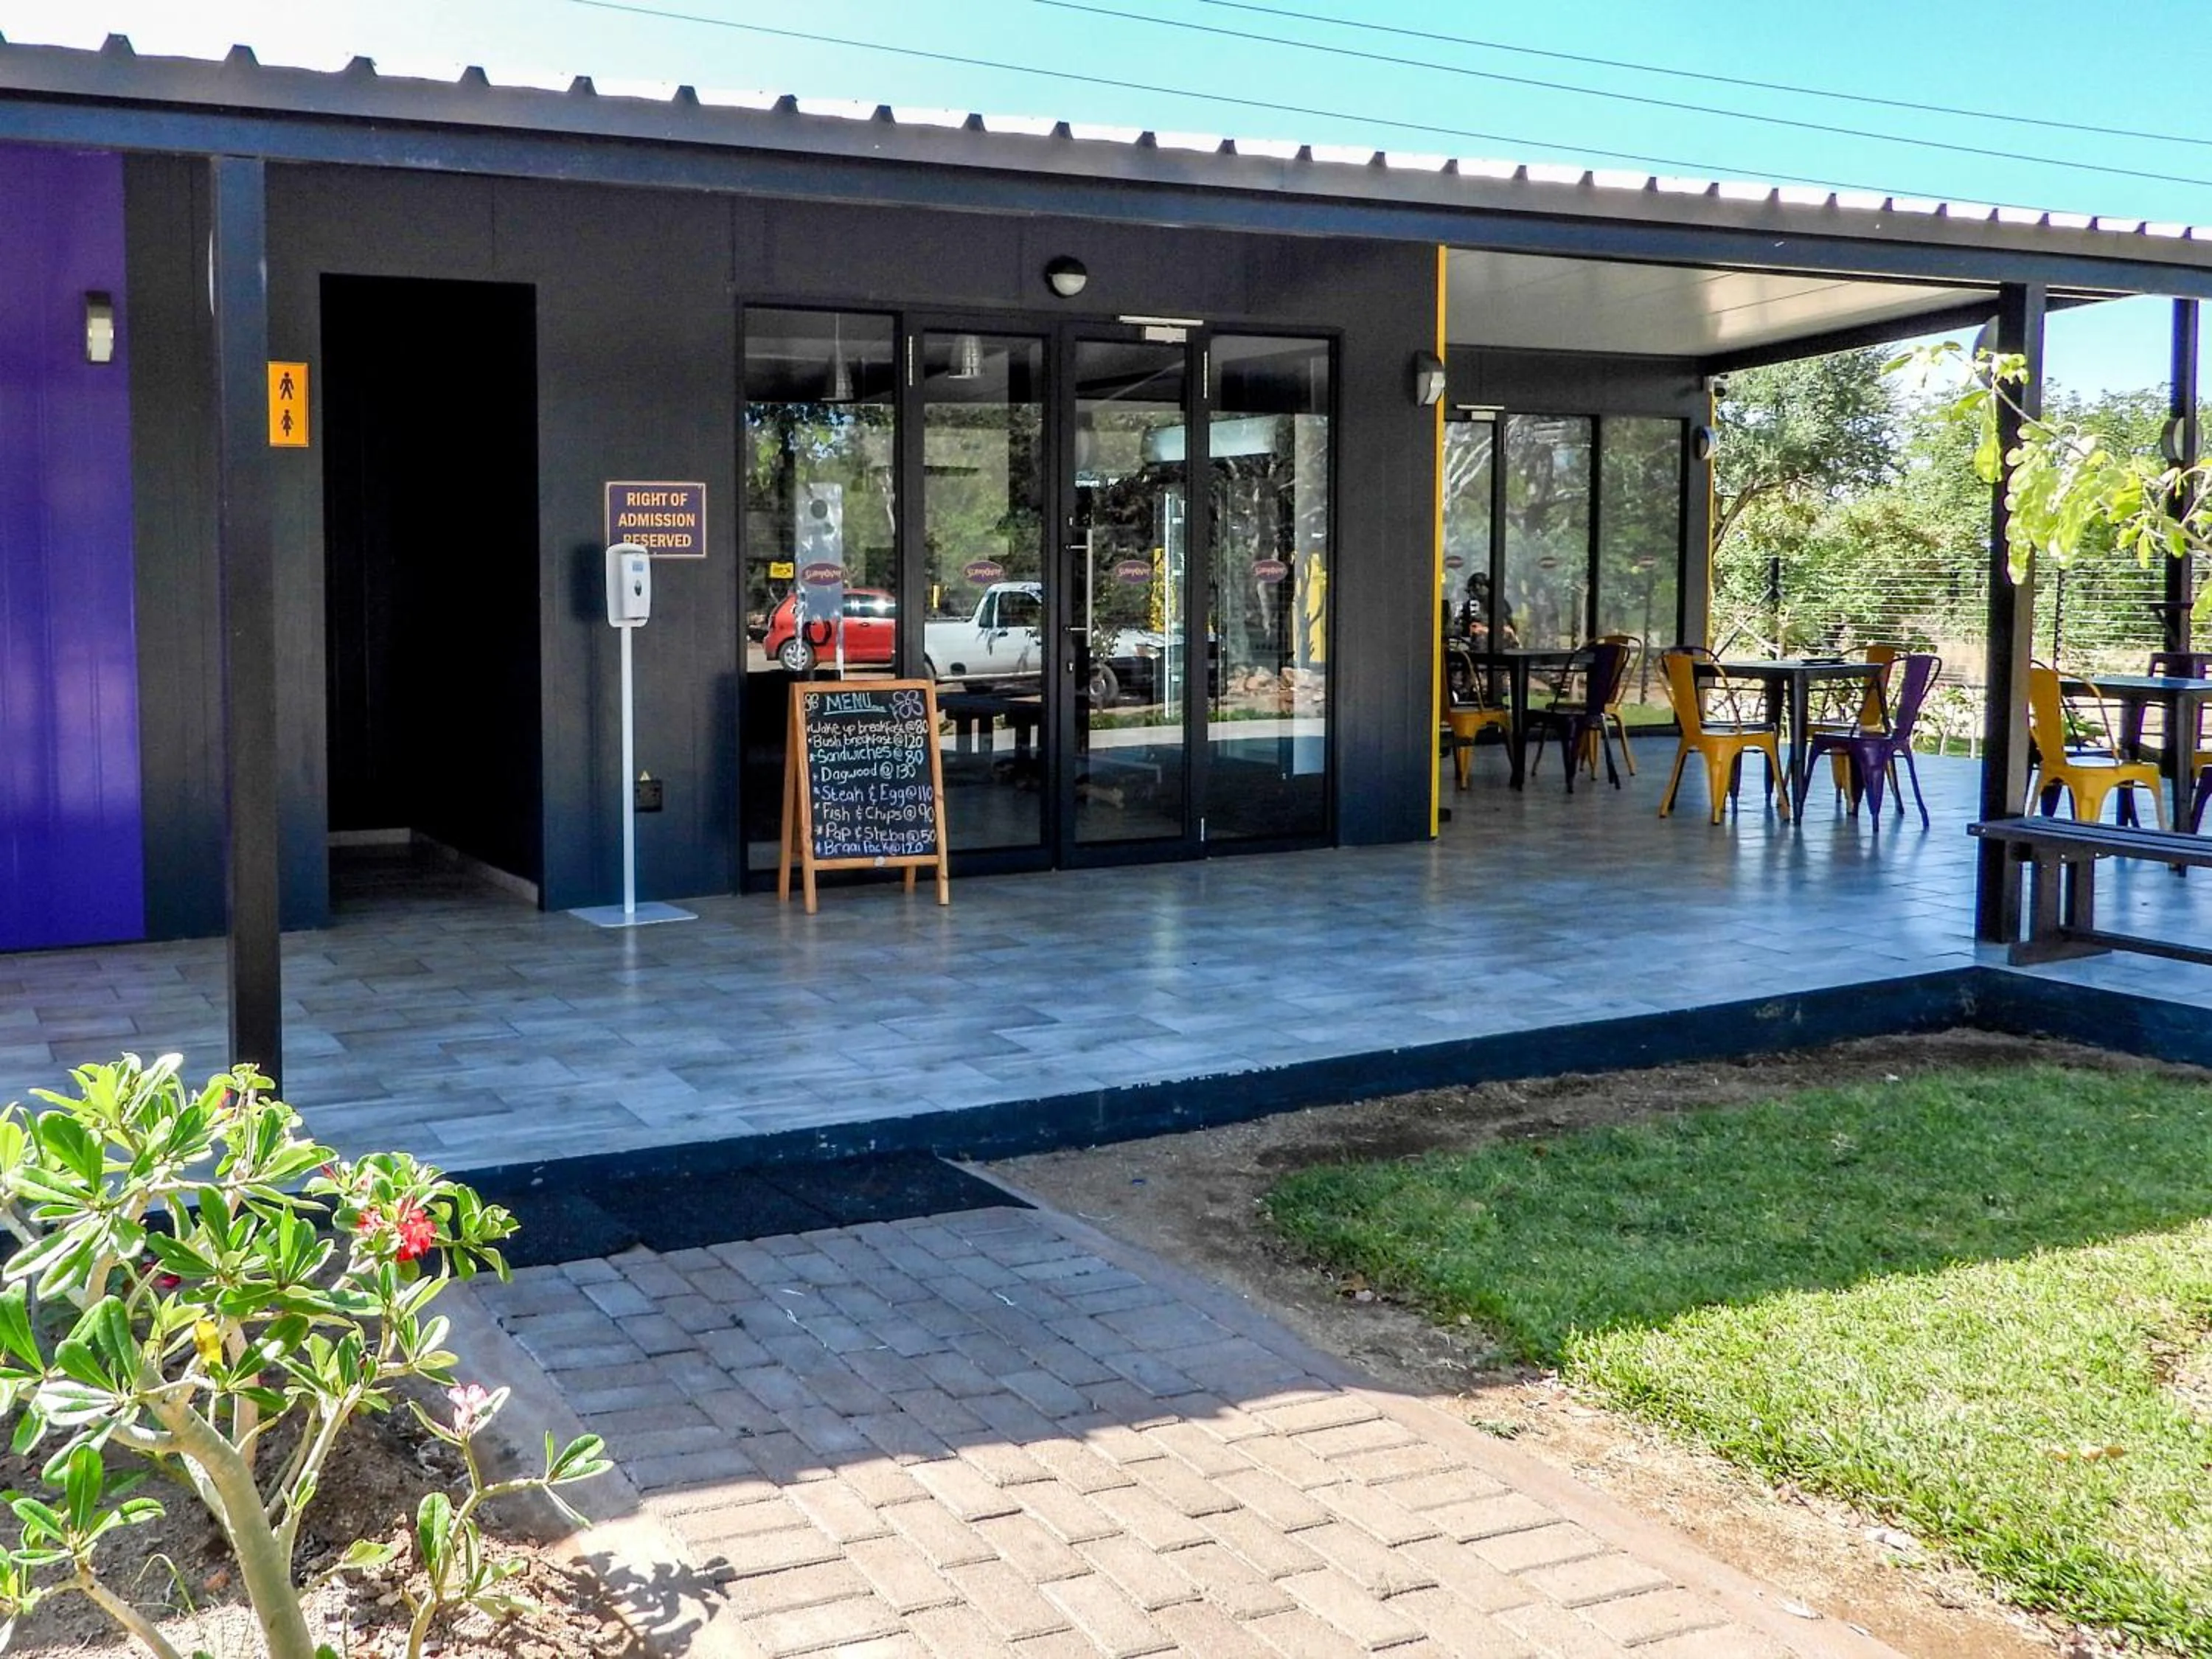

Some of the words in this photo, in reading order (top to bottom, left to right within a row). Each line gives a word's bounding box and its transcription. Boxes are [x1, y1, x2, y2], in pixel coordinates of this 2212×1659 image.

[627, 493, 668, 506] RIGHT
[670, 493, 688, 506] OF
[618, 513, 695, 527] ADMISSION
[825, 692, 872, 710] MENU
[843, 726, 855, 736] up
[821, 762, 877, 785] Dagwood
[822, 801, 850, 822] Fish
[825, 821, 851, 842] Pap
